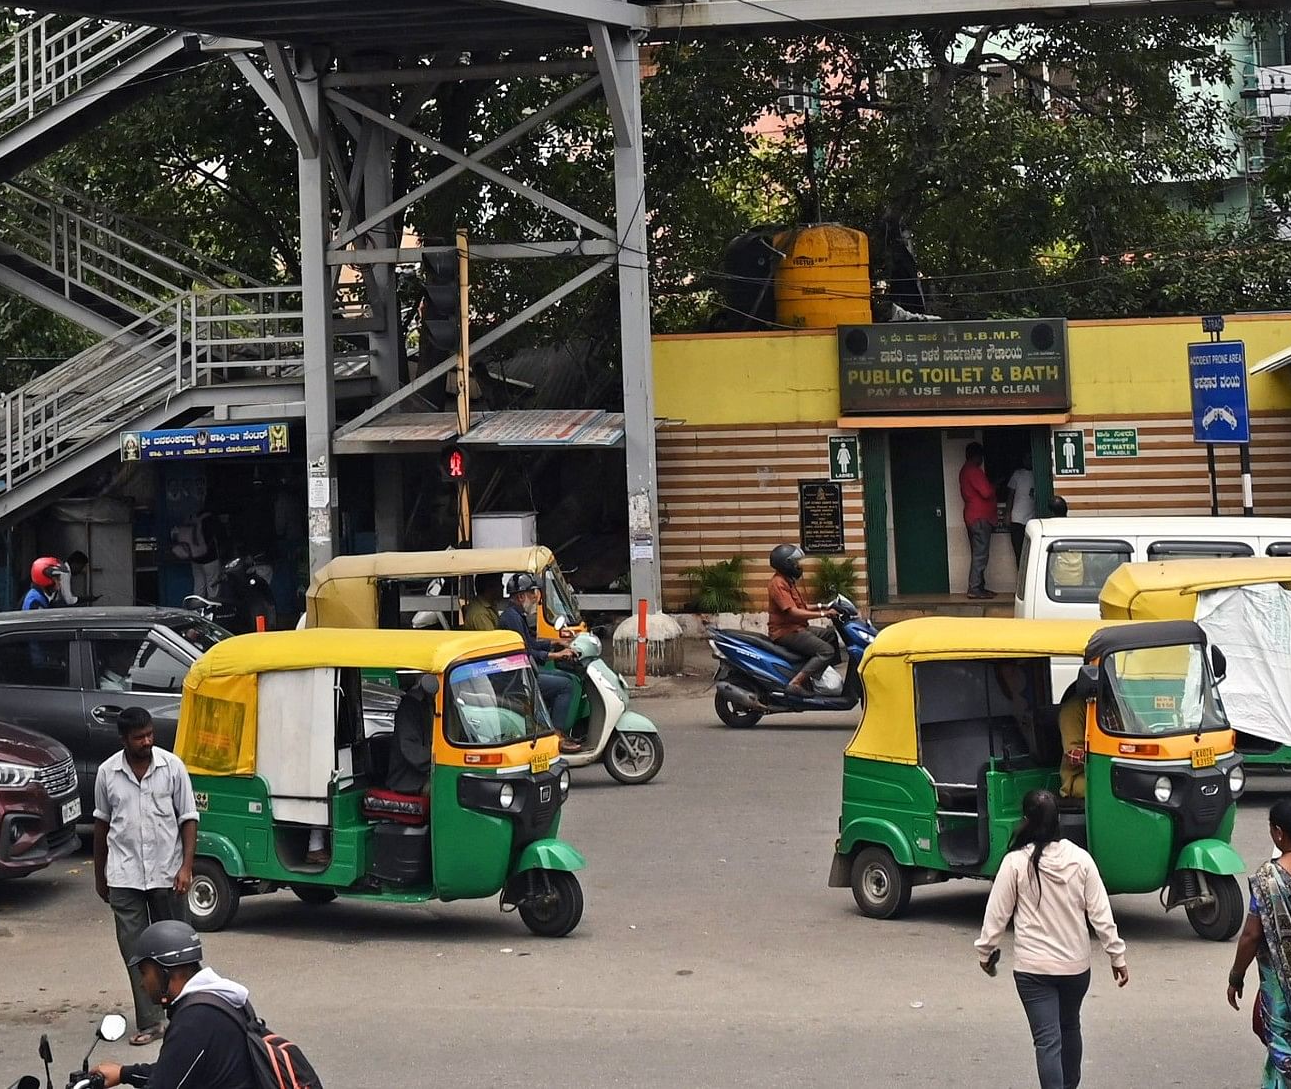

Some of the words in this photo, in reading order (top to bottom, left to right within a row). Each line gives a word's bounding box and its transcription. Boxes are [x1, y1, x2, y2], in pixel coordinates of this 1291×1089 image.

[963, 330, 1022, 342] B.B.M.P.
[1190, 355, 1211, 364] ACCIDENT
[1212, 354, 1228, 364] PRONE
[1229, 353, 1242, 363] AREA
[847, 367, 914, 385] PUBLIC
[919, 367, 984, 383] TOILET
[990, 366, 1004, 382] &
[1010, 365, 1059, 381] BATH
[867, 388, 892, 397] PAY
[898, 388, 908, 396] &
[912, 386, 942, 396] USE
[956, 385, 987, 395] NEAT
[989, 385, 999, 395] &
[1002, 384, 1040, 394] CLEAN
